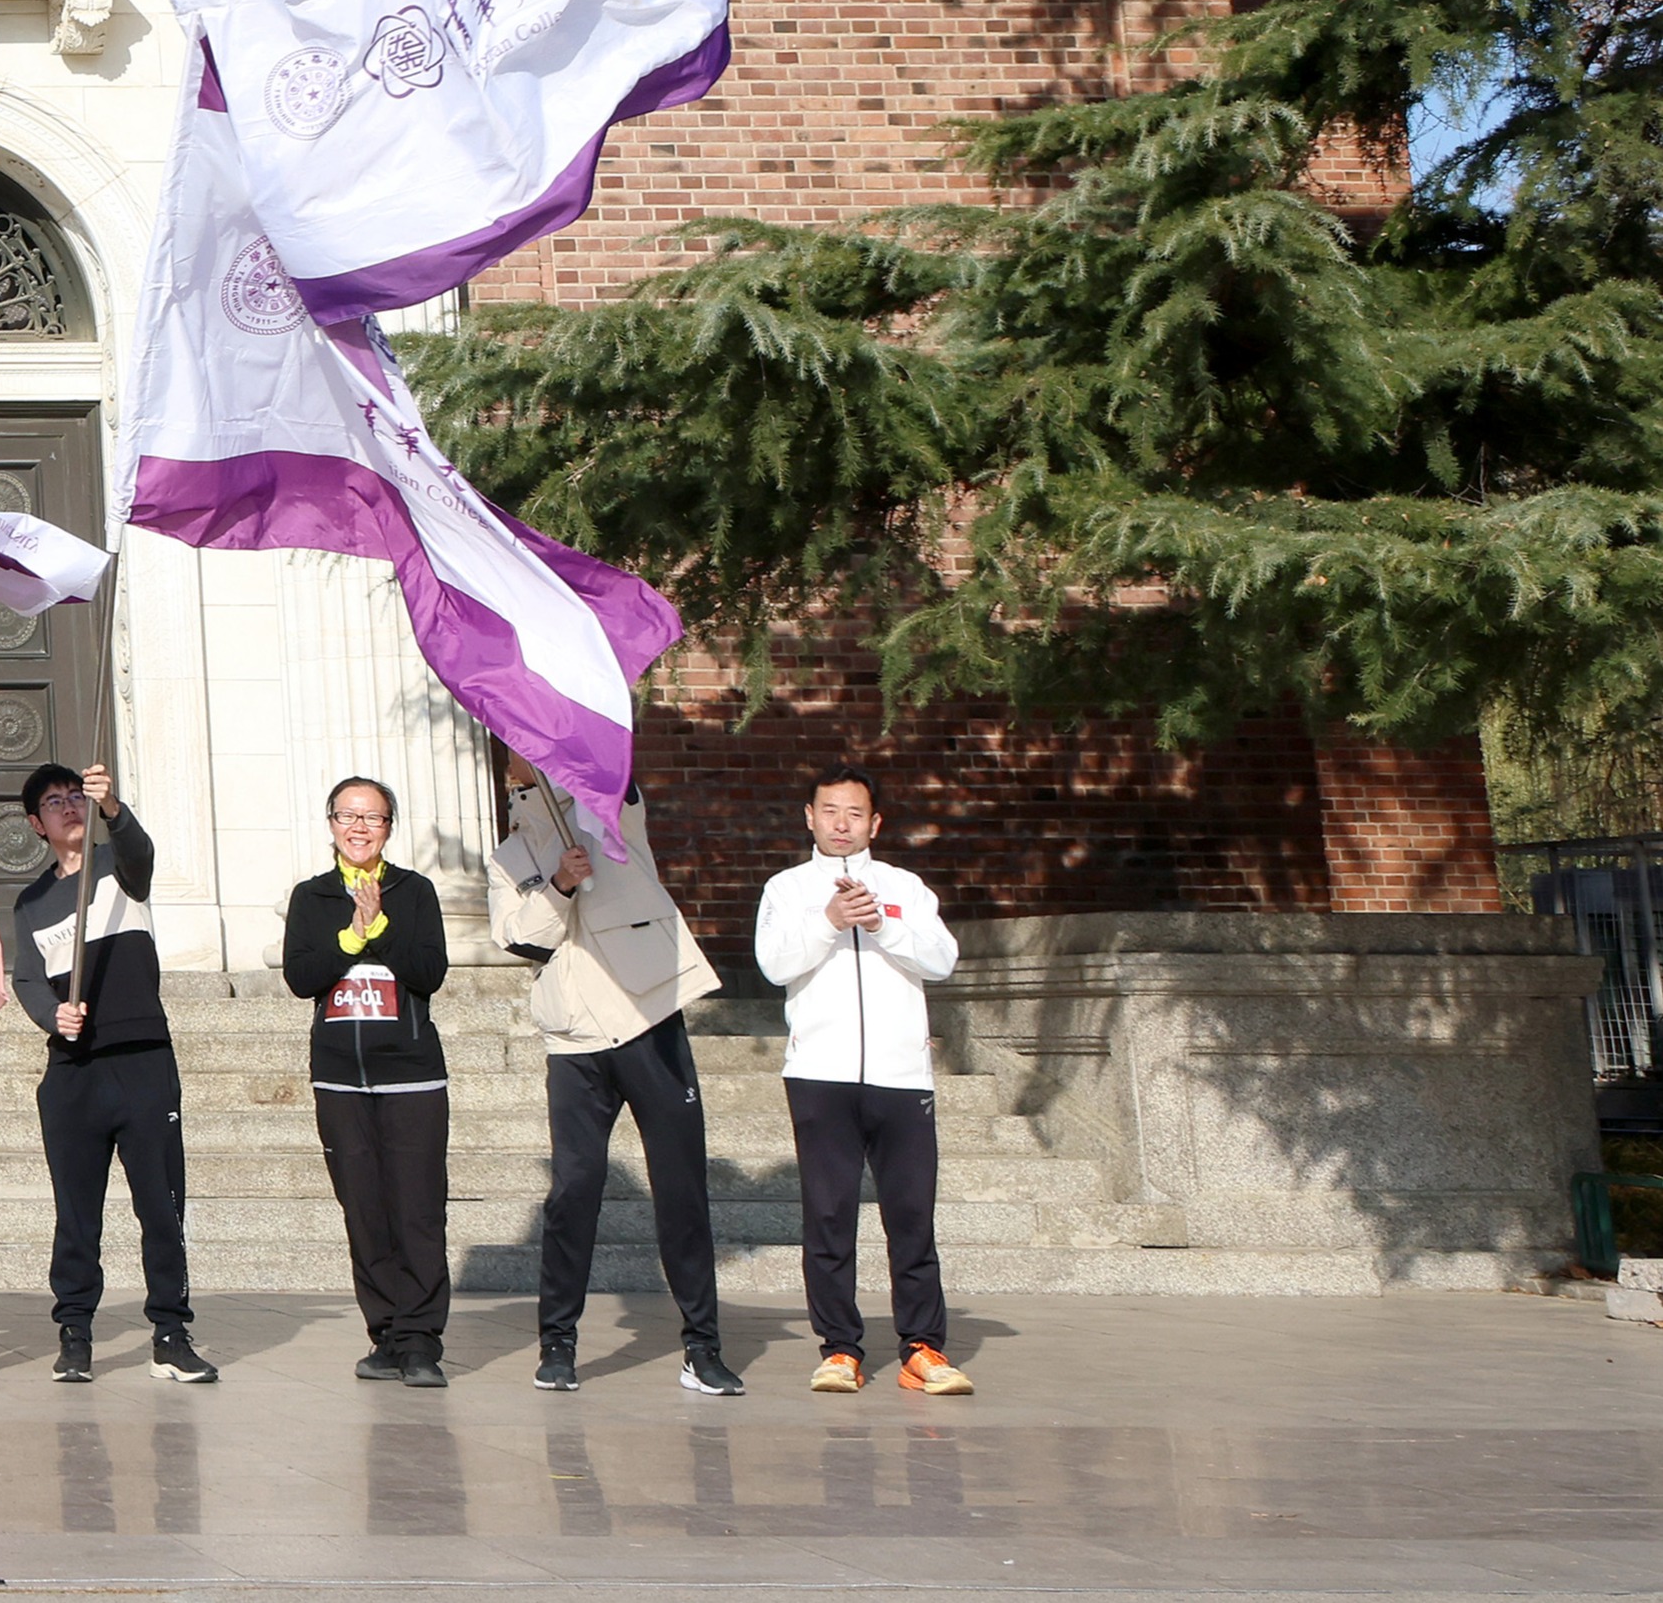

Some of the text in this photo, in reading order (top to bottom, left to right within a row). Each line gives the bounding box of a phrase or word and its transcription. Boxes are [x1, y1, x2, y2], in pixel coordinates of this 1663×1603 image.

[515, 10, 563, 42] Colle
[231, 270, 246, 314] TSINGHUA
[333, 989, 385, 1007] 64-01
